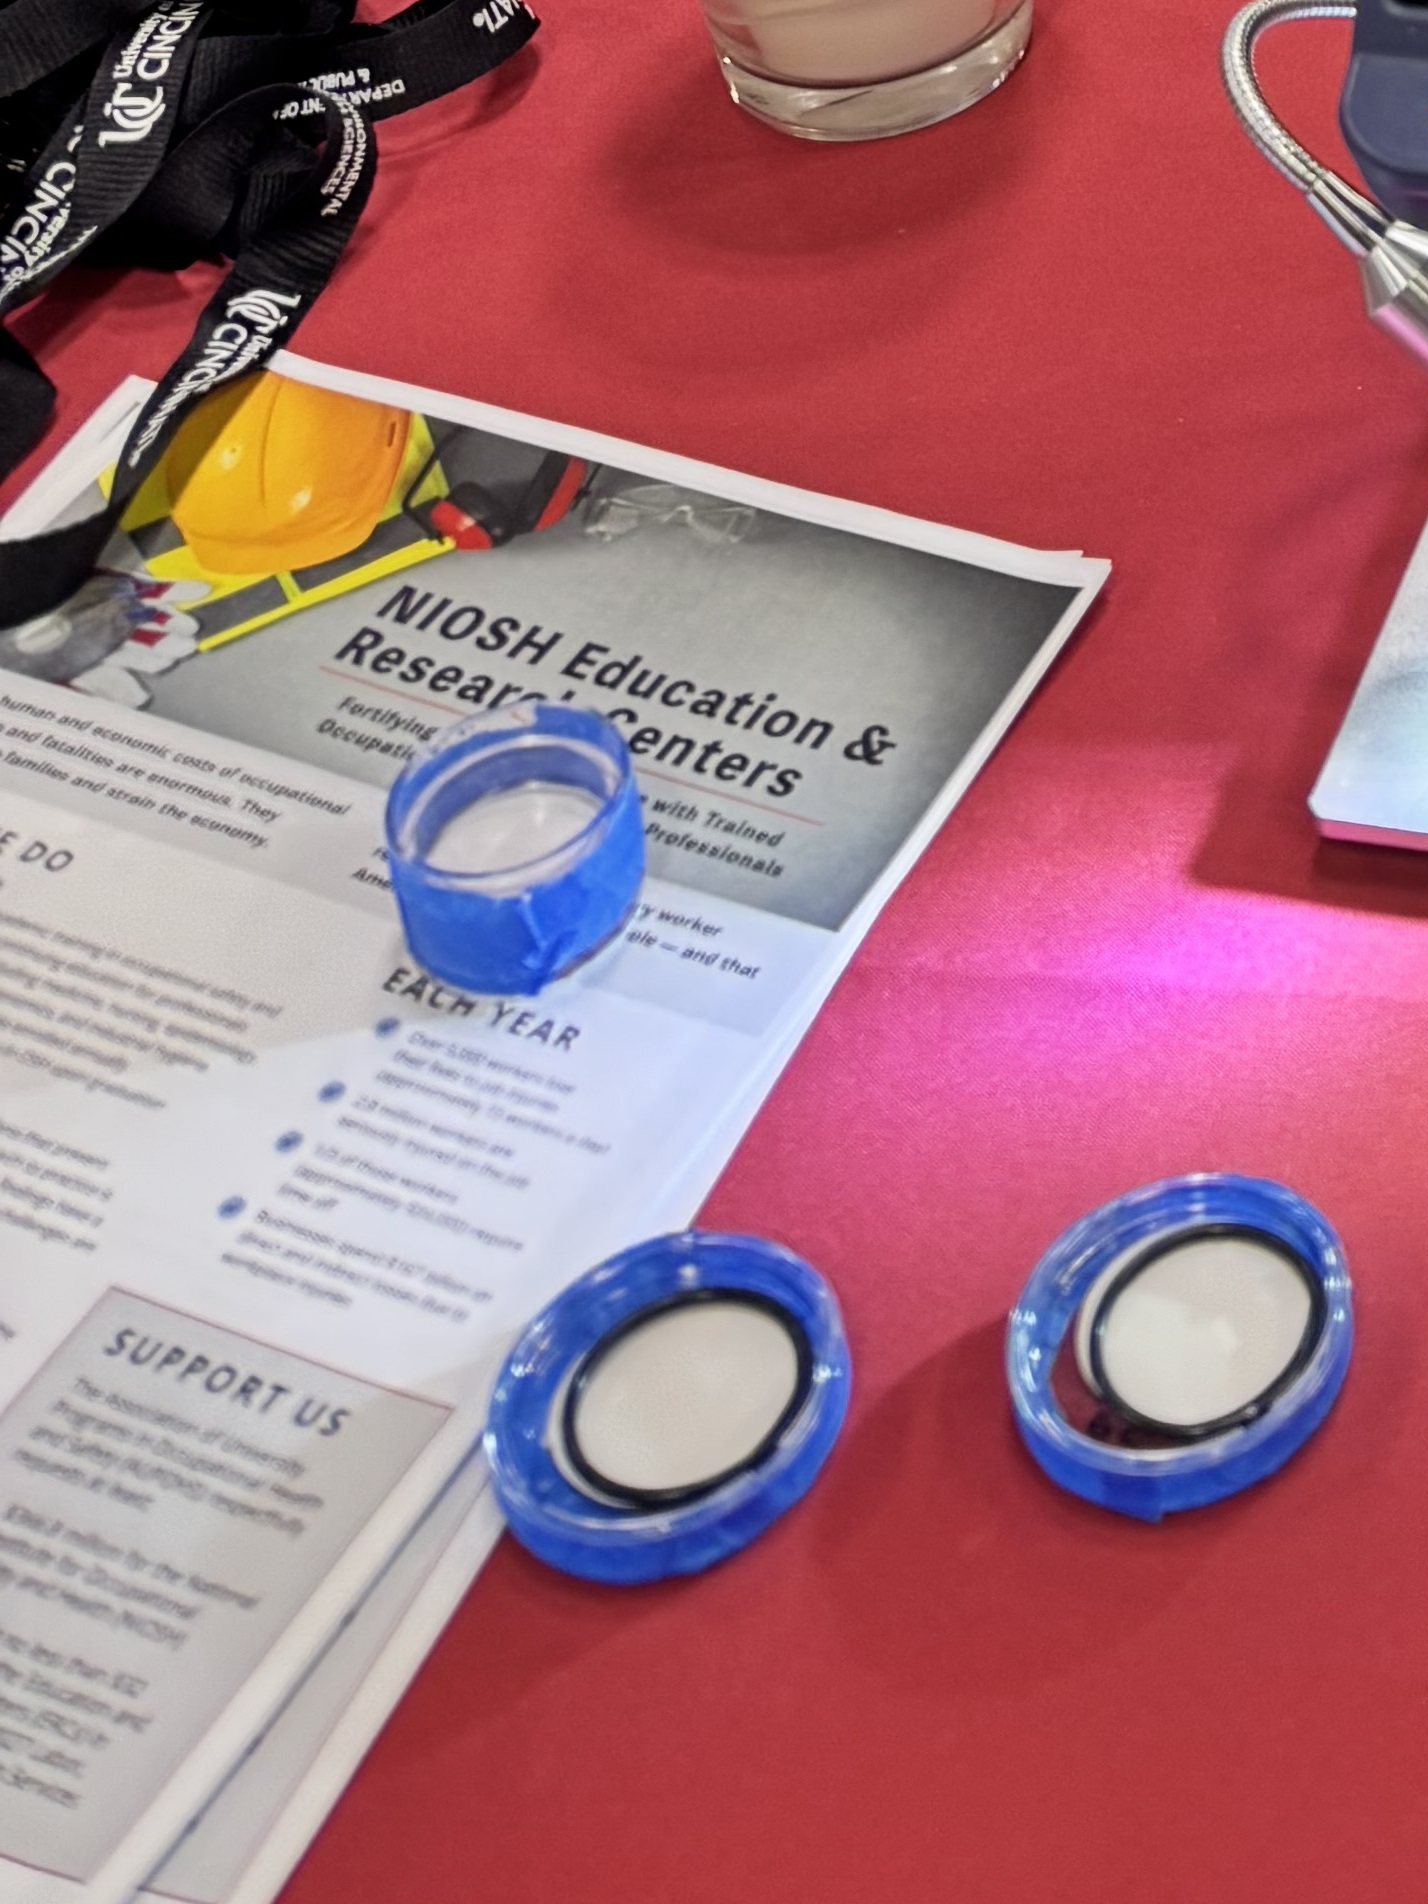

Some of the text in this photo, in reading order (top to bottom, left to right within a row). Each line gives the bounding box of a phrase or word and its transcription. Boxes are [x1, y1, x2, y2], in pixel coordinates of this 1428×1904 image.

[334, 627, 577, 710] Resear
[376, 585, 897, 766] NIOSH Education &
[338, 696, 439, 742] Fortifying
[19, 841, 74, 873] DO
[645, 823, 784, 879] Professionals
[652, 799, 785, 848] with Trained
[382, 968, 583, 1051] EACH YEAR
[103, 1329, 352, 1437] SUPPORT US
